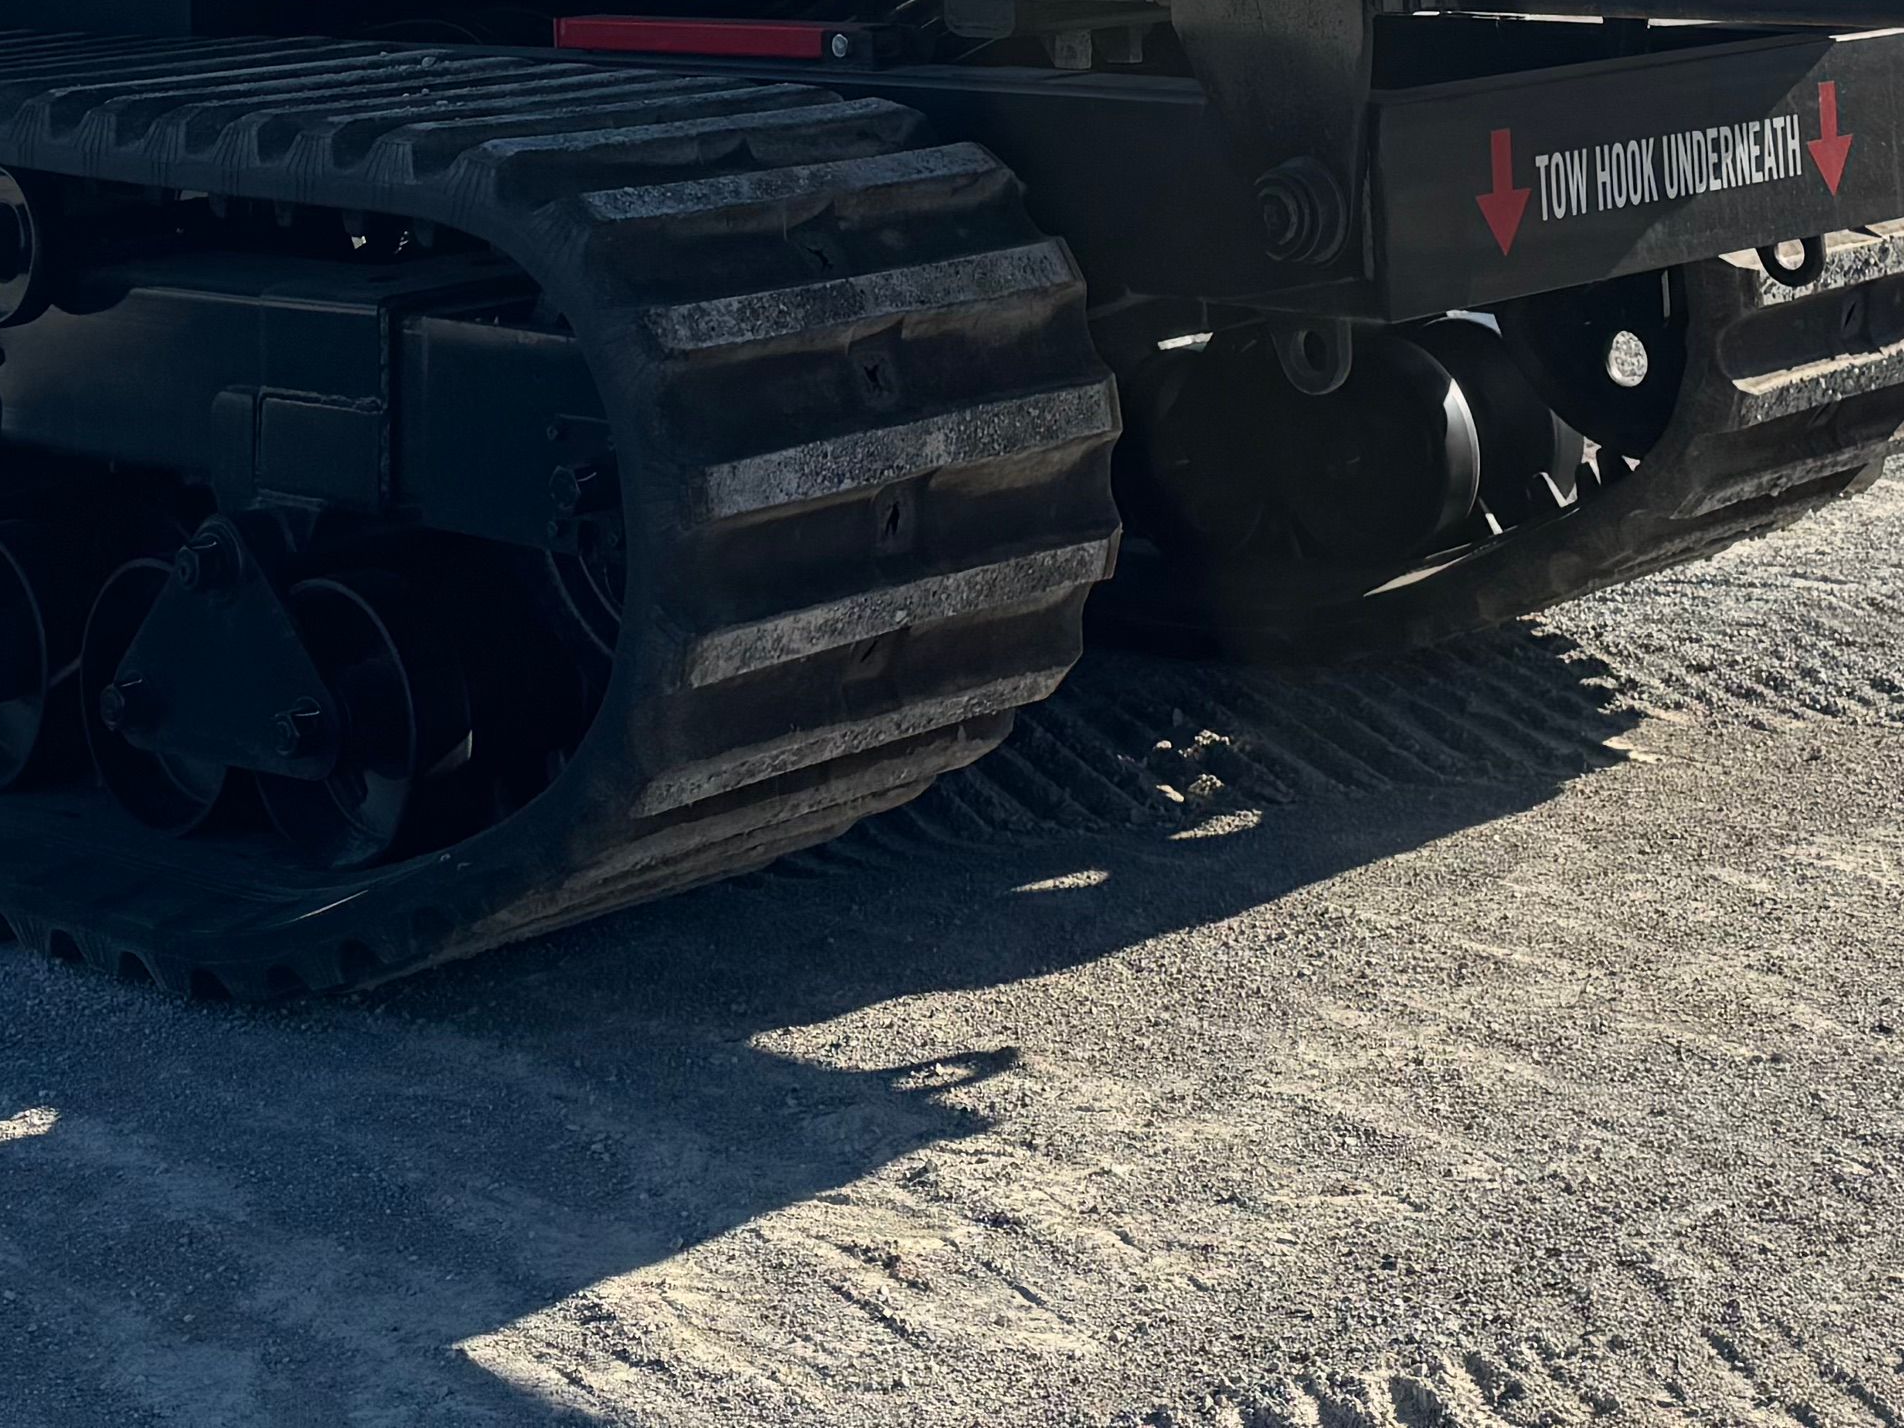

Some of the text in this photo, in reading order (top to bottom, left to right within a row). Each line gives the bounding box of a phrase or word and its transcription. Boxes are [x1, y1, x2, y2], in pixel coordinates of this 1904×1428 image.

[1535, 115, 1802, 221] TOW HOOK UNDERNEATH
